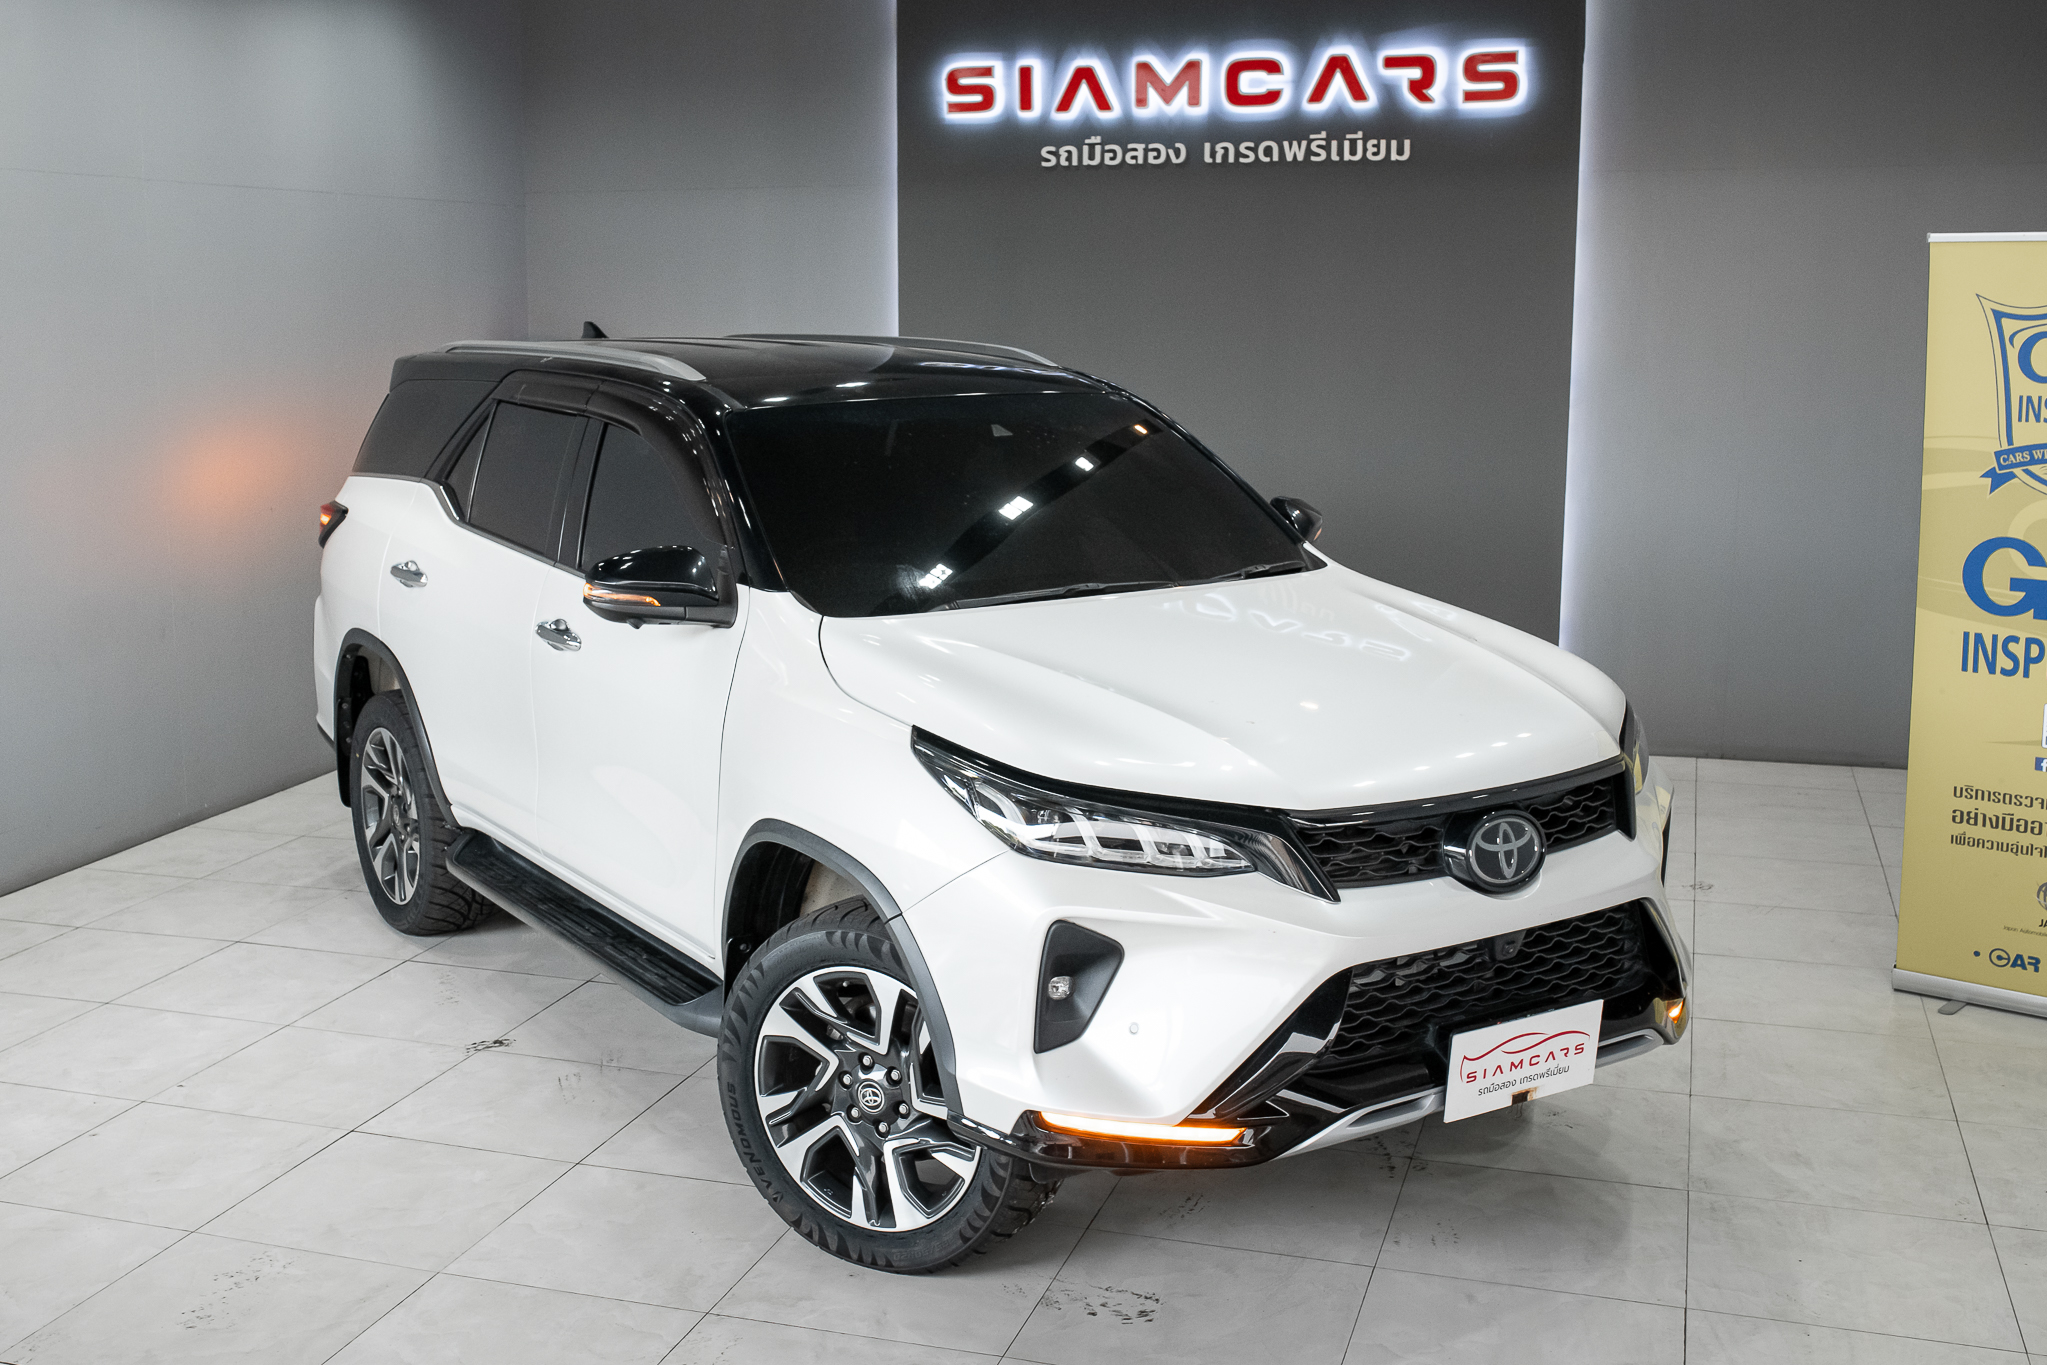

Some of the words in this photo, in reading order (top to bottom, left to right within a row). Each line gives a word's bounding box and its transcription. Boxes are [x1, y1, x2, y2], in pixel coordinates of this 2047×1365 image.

[944, 49, 1520, 114] SIAMCARS
[1041, 136, 1187, 167] รถมือสอง
[1203, 131, 1411, 164] เกรดพรีเมียม
[2000, 451, 2030, 466] CARS
[1961, 631, 2046, 679] INSP
[1953, 785, 2047, 810] บริการตรวจ
[1951, 807, 2047, 836] อย่างมืออ
[1466, 1042, 1585, 1084] SIAMCARS
[1478, 1079, 1517, 1096] รถมือสอง
[726, 1081, 773, 1190] VENOMOUS
